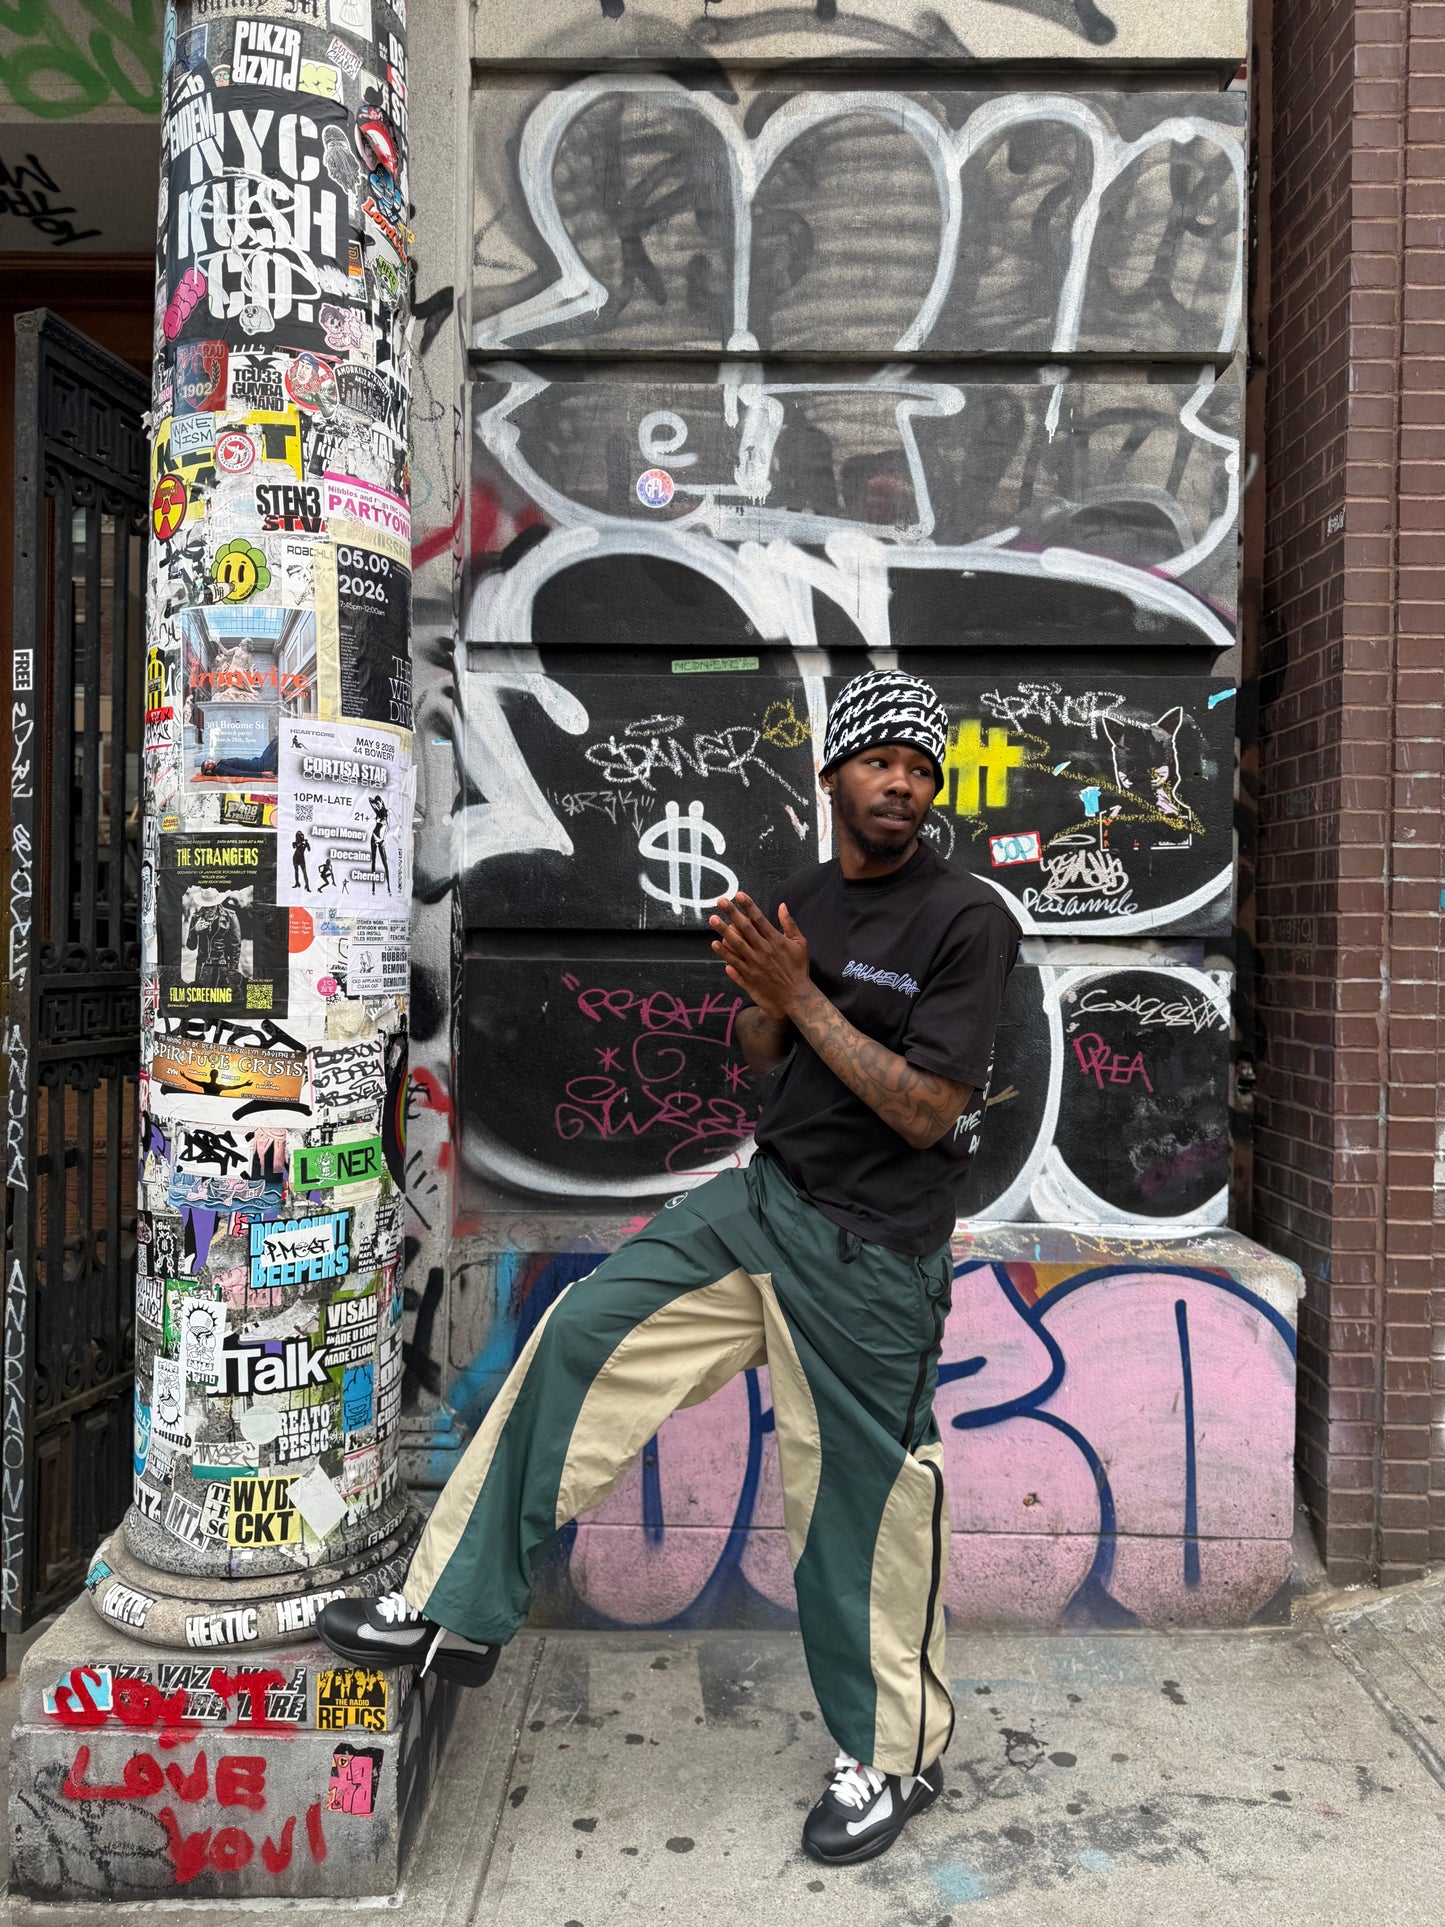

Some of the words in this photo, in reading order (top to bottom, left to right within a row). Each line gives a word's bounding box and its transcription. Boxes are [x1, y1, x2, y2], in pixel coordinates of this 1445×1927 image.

[236, 20, 301, 56] PIKZR
[190, 109, 320, 184] NYC
[183, 382, 214, 399] 1902
[232, 382, 284, 398] GUMBA
[172, 417, 212, 437] WAVE
[255, 483, 321, 517] STEN3
[328, 485, 358, 498] Nibbles
[360, 493, 373, 503] and
[337, 546, 393, 579] 05.09.
[339, 574, 390, 604] 2026.
[14, 650, 32, 689] FREE
[189, 664, 310, 689] ironwire
[220, 720, 254, 729] Broome
[290, 728, 335, 738] HEARTCORE
[353, 746, 363, 755] 44
[364, 748, 395, 762] BOWERY
[356, 737, 374, 748] MAY
[375, 742, 380, 750] 9
[381, 744, 396, 754] 2026
[303, 756, 360, 778] CORTISA
[361, 764, 388, 783] STAR
[293, 792, 353, 806] 10PM-LATE
[354, 812, 370, 822] 21+
[312, 825, 340, 838] Angel
[340, 828, 367, 842] Money
[176, 847, 191, 867] THE
[194, 847, 259, 867] STRANGERS
[330, 848, 371, 861] Doecaine
[169, 987, 185, 1002] FILM
[186, 987, 233, 1003] SCREENING
[953, 1109, 982, 1142] THE
[251, 1244, 349, 1289] BEEPERS
[359, 1322, 377, 1339] LOOK
[325, 1350, 350, 1367] MADE
[350, 1348, 357, 1360] U
[234, 1510, 294, 1544] CKT
[101, 1582, 155, 1628] HEKTIC
[186, 1608, 259, 1648] HEKTIC
[335, 1698, 348, 1707] THE
[349, 1699, 370, 1707] RADIO
[318, 1707, 386, 1731] RELICS
[64, 1745, 267, 1811] LOVE
